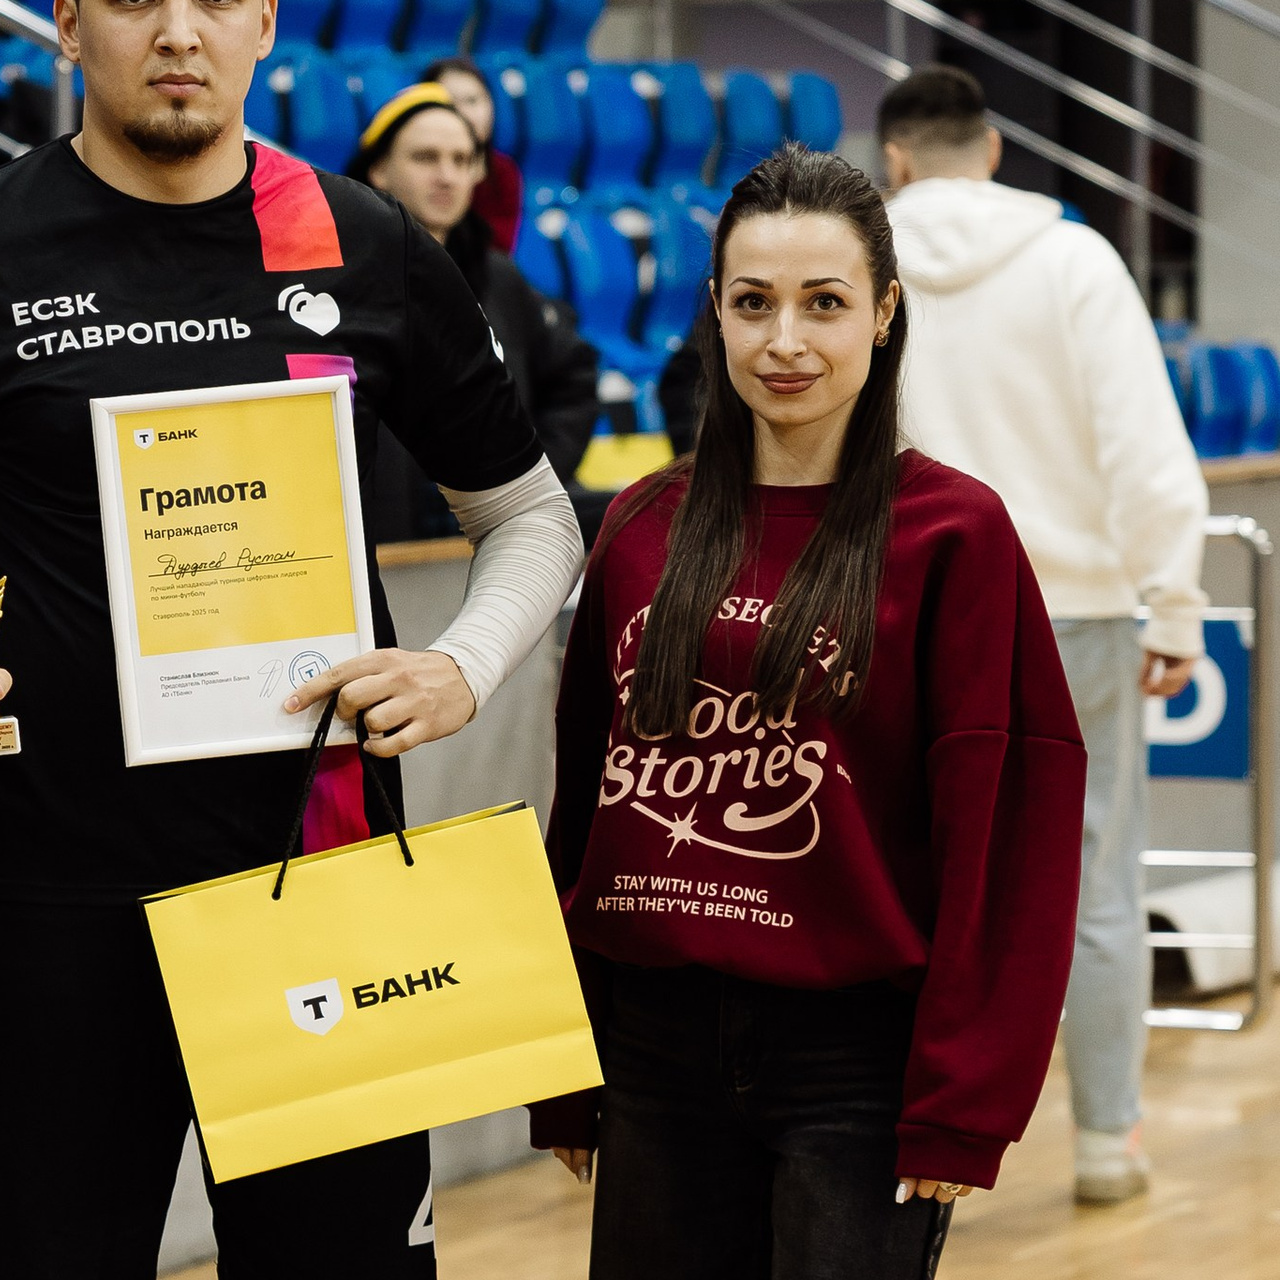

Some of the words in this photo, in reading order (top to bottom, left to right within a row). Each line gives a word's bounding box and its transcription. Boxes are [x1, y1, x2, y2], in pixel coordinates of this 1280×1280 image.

[11, 292, 101, 327] ЕСЗК
[16, 317, 252, 361] СТАВРОПОЛЬ
[158, 429, 198, 442] БАНК
[140, 479, 267, 516] Грамота
[144, 521, 238, 540] Награждается
[236, 547, 295, 571] Рустам
[149, 583, 175, 593] Лучший
[176, 579, 218, 590] нападающий
[219, 576, 245, 586] турнира
[246, 572, 279, 583] цифровых
[280, 570, 308, 579] лидеров
[160, 590, 206, 601] мини-футболу
[152, 610, 190, 621] Ставрополь
[191, 608, 207, 617] 2025
[208, 607, 220, 616] год
[599, 727, 827, 832] Stories
[614, 875, 648, 890] STAY
[650, 876, 692, 894] WITH
[696, 881, 718, 897] US
[722, 884, 769, 904] LONG
[596, 897, 634, 911] AFTER
[637, 897, 700, 915] THEY'VE
[704, 902, 746, 920] BEEN
[750, 908, 794, 928] TOLD
[302, 994, 328, 1021] Т
[351, 962, 461, 1010] БАНК
